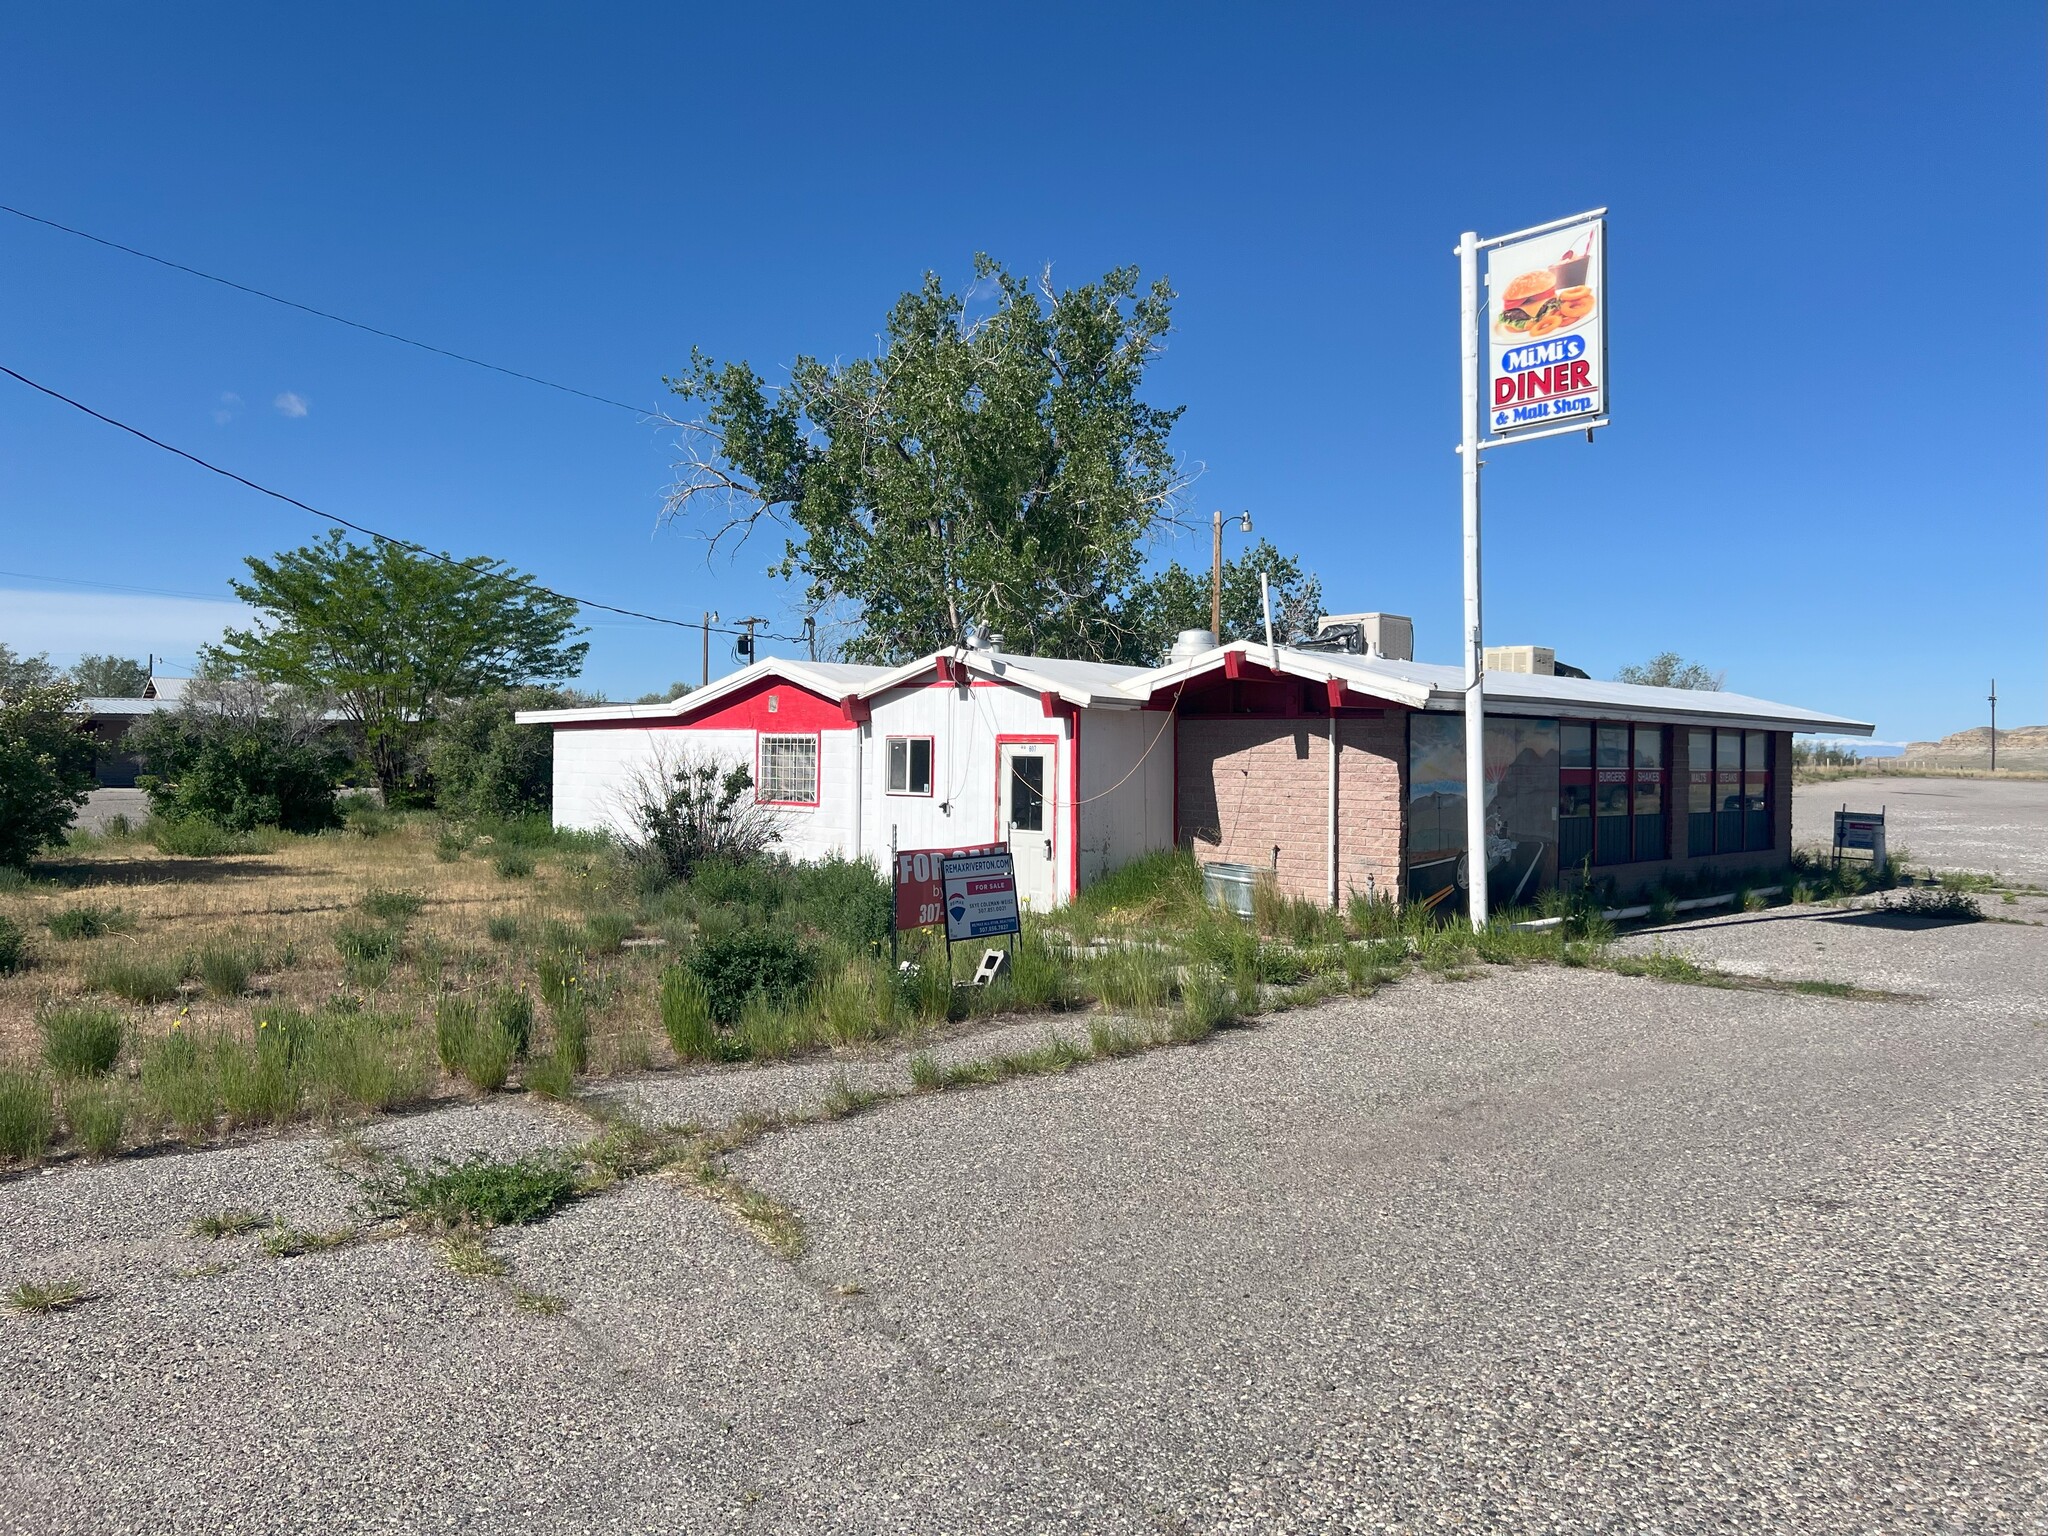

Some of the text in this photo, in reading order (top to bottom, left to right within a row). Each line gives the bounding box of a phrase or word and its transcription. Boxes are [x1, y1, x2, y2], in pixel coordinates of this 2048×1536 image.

[1495, 360, 1592, 406] DINER
[1496, 397, 1593, 425] & Malt Shop
[1598, 771, 1626, 782] BURGERS
[1637, 771, 1660, 782] SHAKES
[1691, 773, 1707, 783] MALTS
[1719, 773, 1737, 783] STEAKS
[900, 852, 945, 884] FOR
[945, 859, 1010, 874] REMAXRIVERTON.COM
